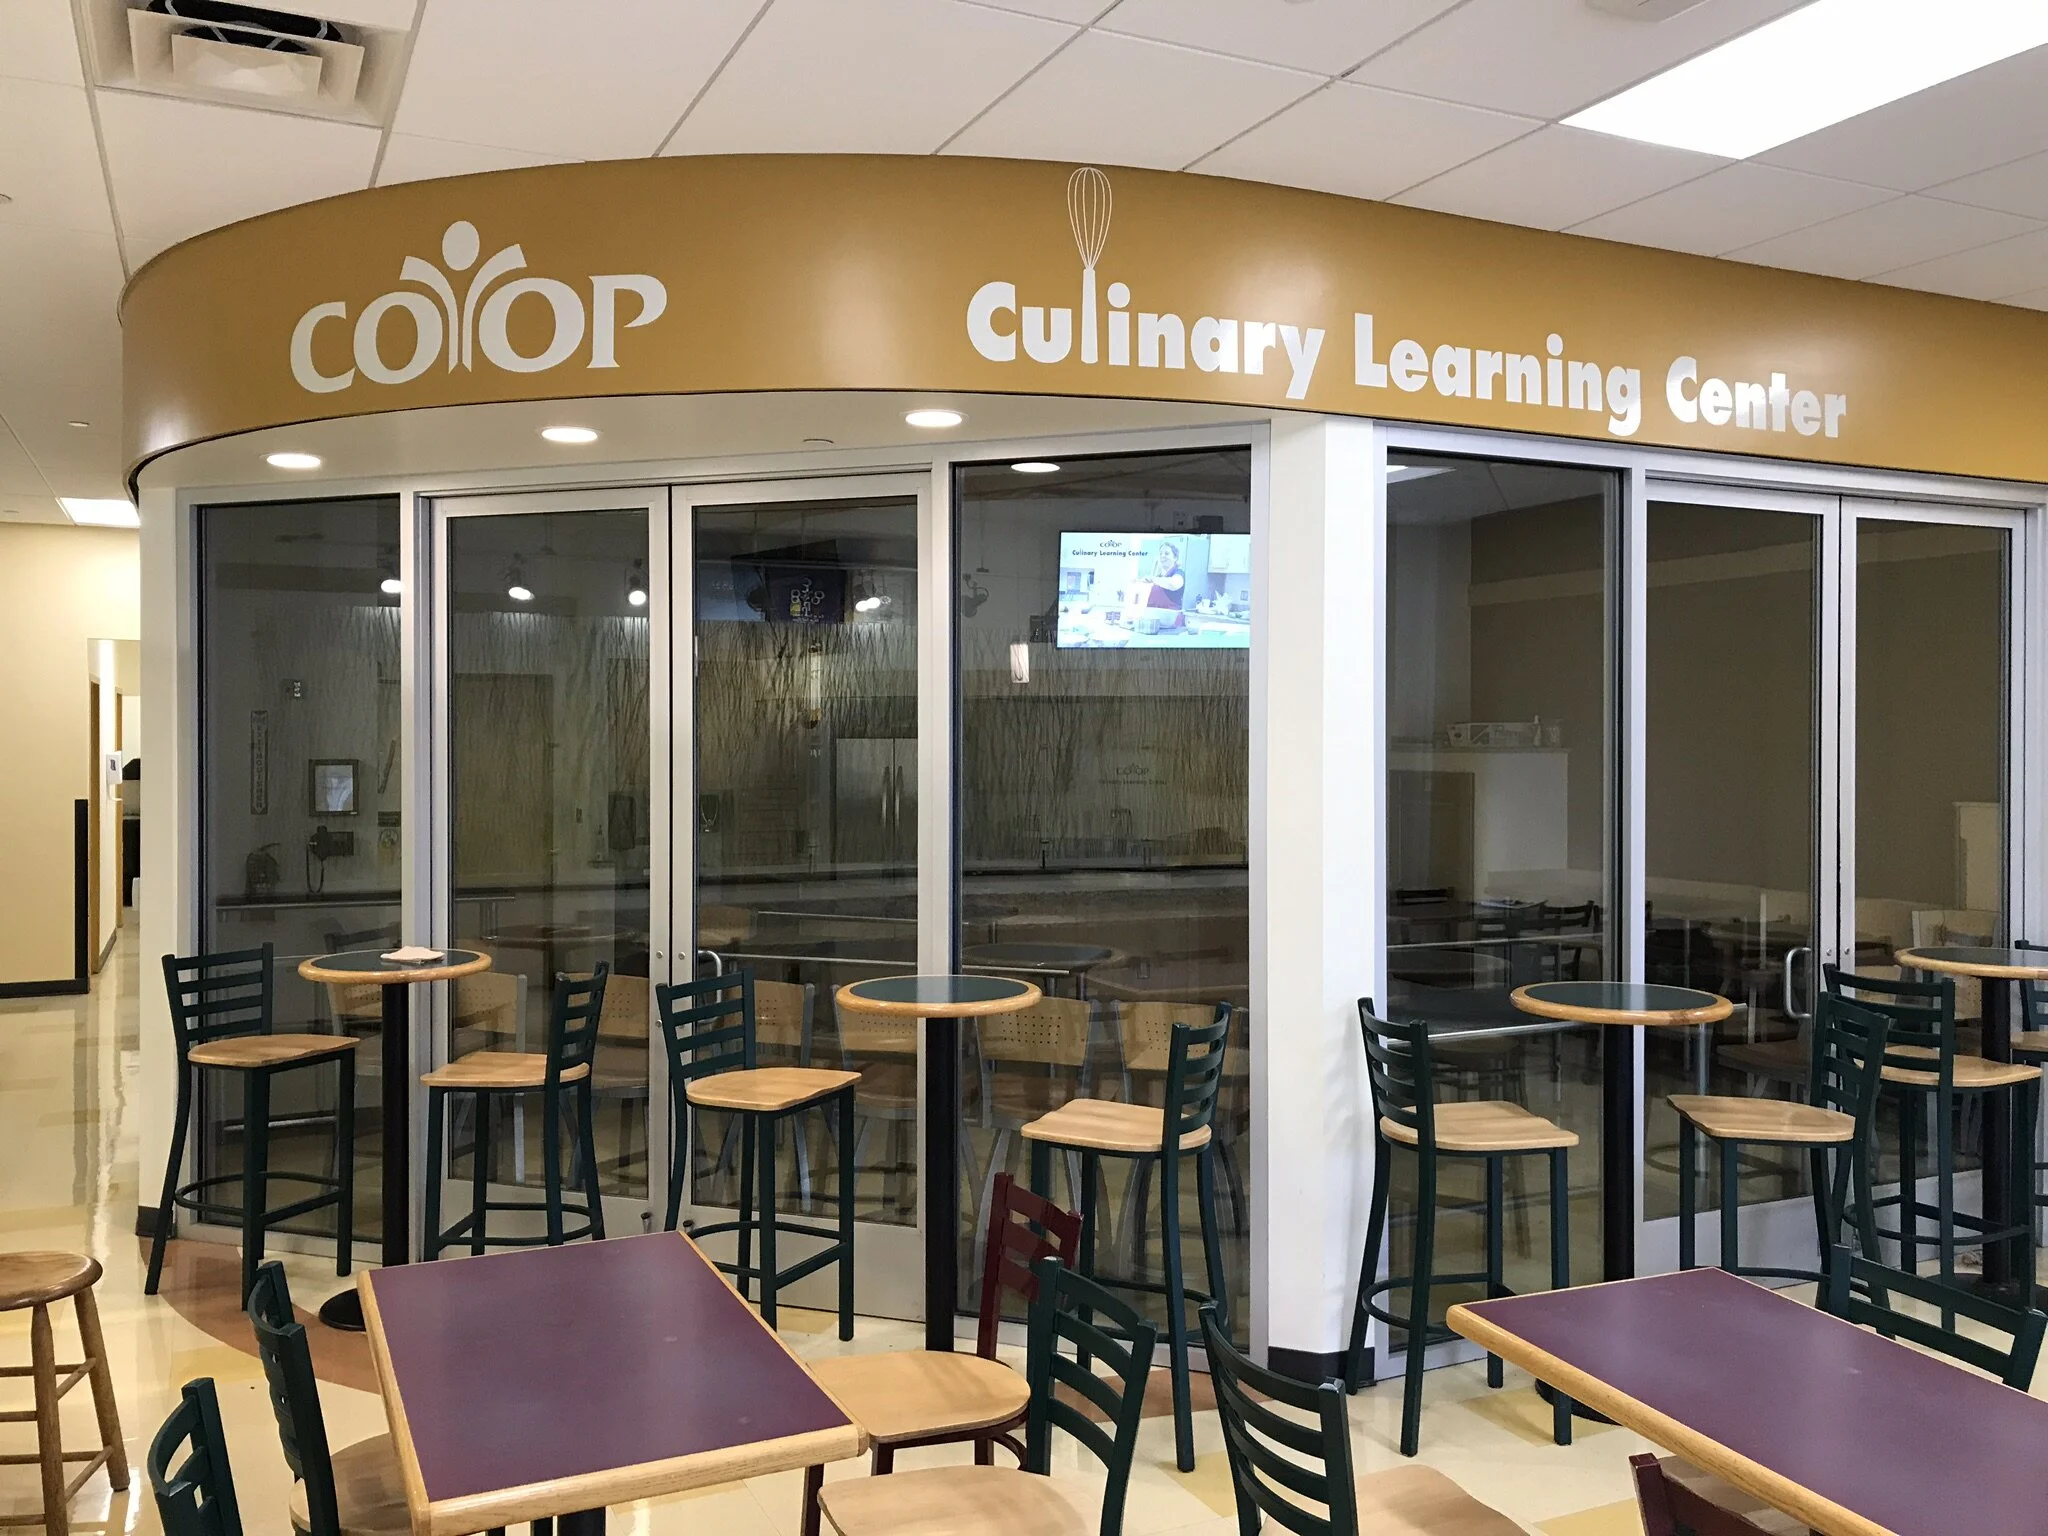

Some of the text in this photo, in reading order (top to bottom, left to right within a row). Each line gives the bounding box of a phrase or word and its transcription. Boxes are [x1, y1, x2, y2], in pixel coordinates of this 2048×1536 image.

[966, 266, 1847, 439] Culinary Learning Center
[1072, 548, 1097, 557] Culinary
[1099, 549, 1126, 557] Learning
